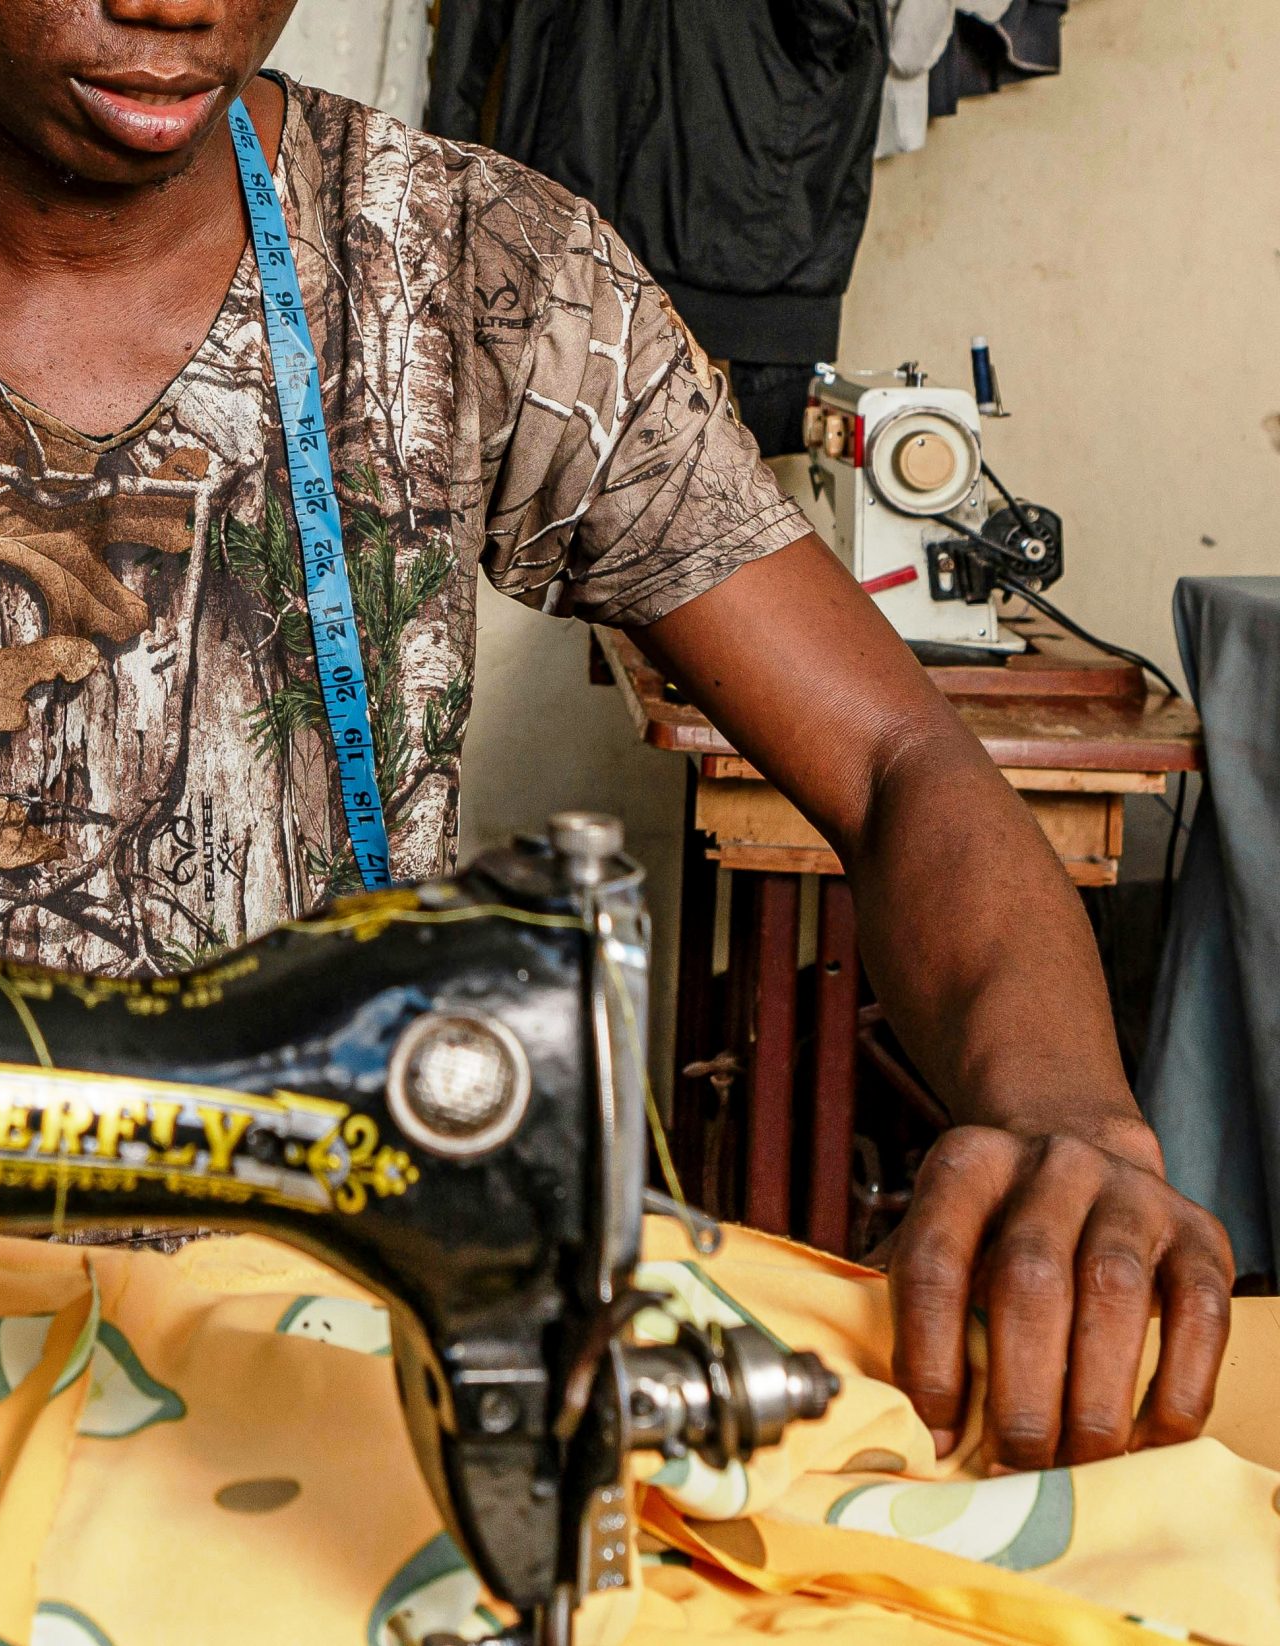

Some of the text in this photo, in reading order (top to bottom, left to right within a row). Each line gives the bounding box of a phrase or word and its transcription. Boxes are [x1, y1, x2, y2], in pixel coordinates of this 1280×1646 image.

[235, 117, 388, 884] 17 18 19 20 21 22 23 24 25 26 27 28 29
[202, 797, 215, 902] REALTREE
